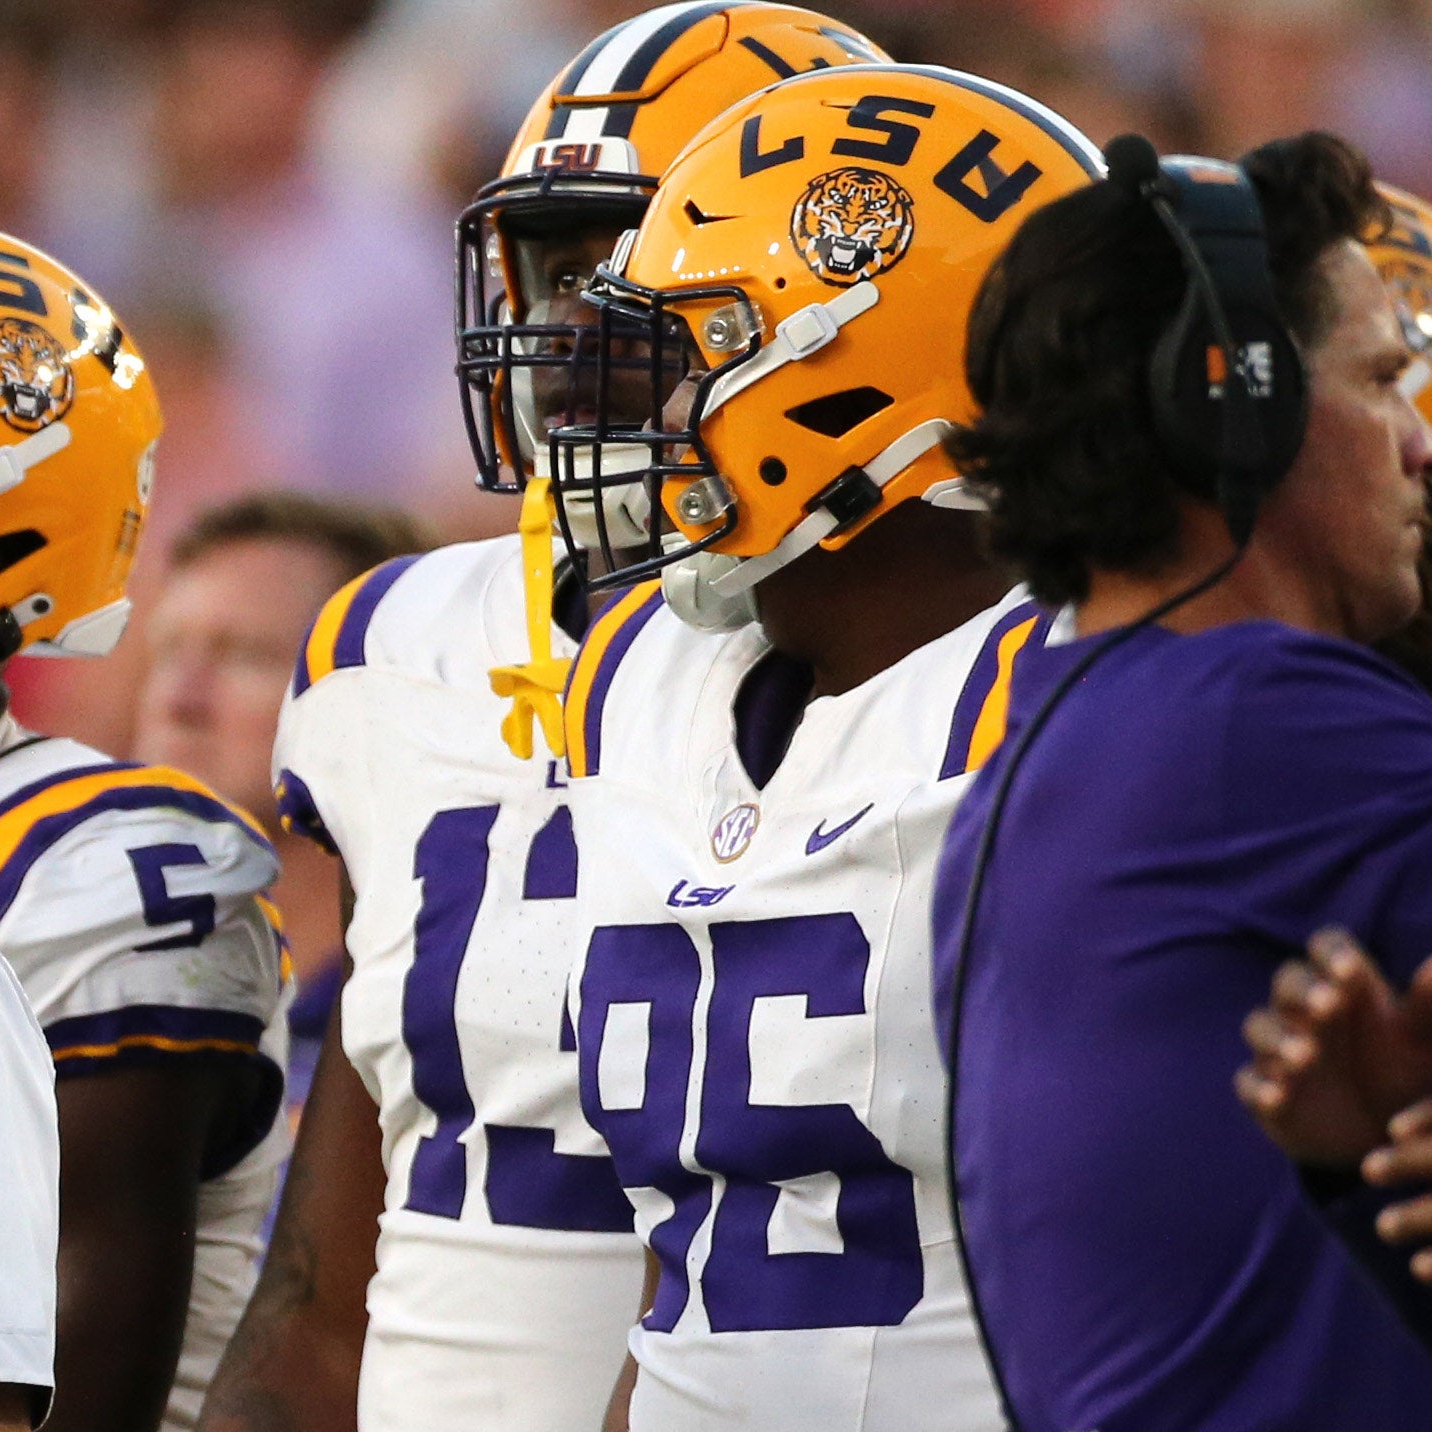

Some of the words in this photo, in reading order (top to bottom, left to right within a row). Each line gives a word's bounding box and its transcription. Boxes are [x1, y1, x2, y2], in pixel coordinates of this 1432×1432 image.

[536, 143, 603, 172] LSU
[739, 94, 1044, 224] LSU
[124, 843, 216, 954] 5
[666, 879, 736, 907] LSU
[578, 911, 924, 1335] 96
